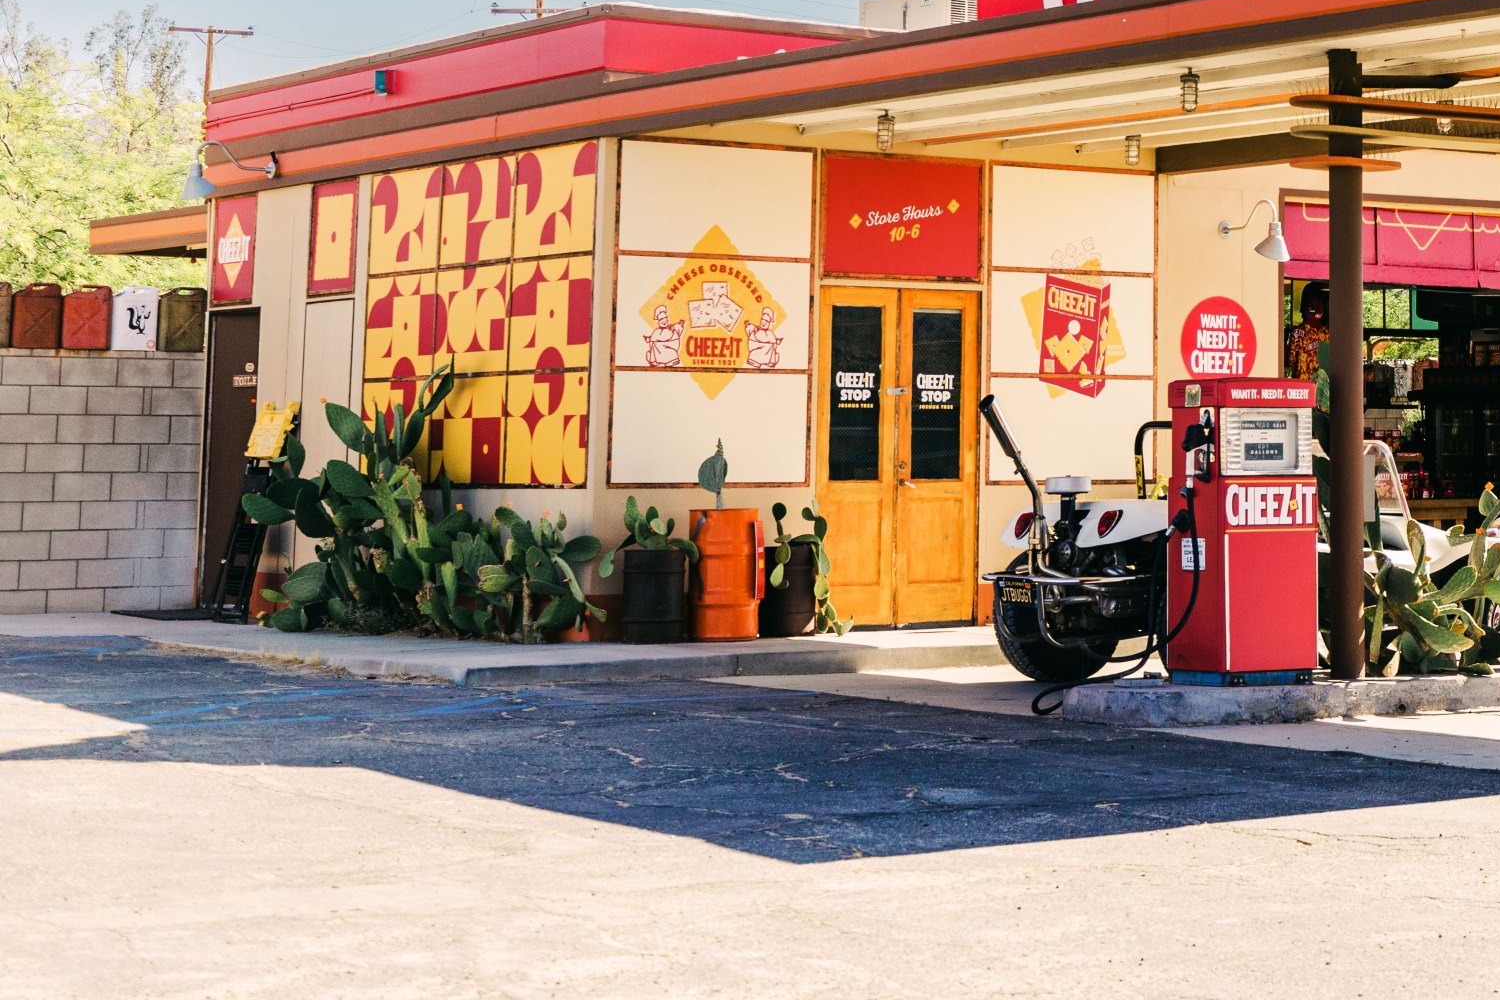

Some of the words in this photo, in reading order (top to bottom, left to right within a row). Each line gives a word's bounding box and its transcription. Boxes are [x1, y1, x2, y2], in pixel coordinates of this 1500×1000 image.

[866, 210, 900, 227] Store
[902, 205, 944, 221] Hours
[889, 223, 920, 242] 10-6
[666, 265, 705, 301] CHEESE
[709, 263, 764, 304] OBSESSED
[1200, 313, 1229, 329] WANT
[1196, 329, 1228, 349] NEED
[840, 388, 872, 401] STOP
[920, 390, 951, 403] STOP
[1231, 388, 1251, 399] WANT
[1261, 388, 1277, 399] NEED
